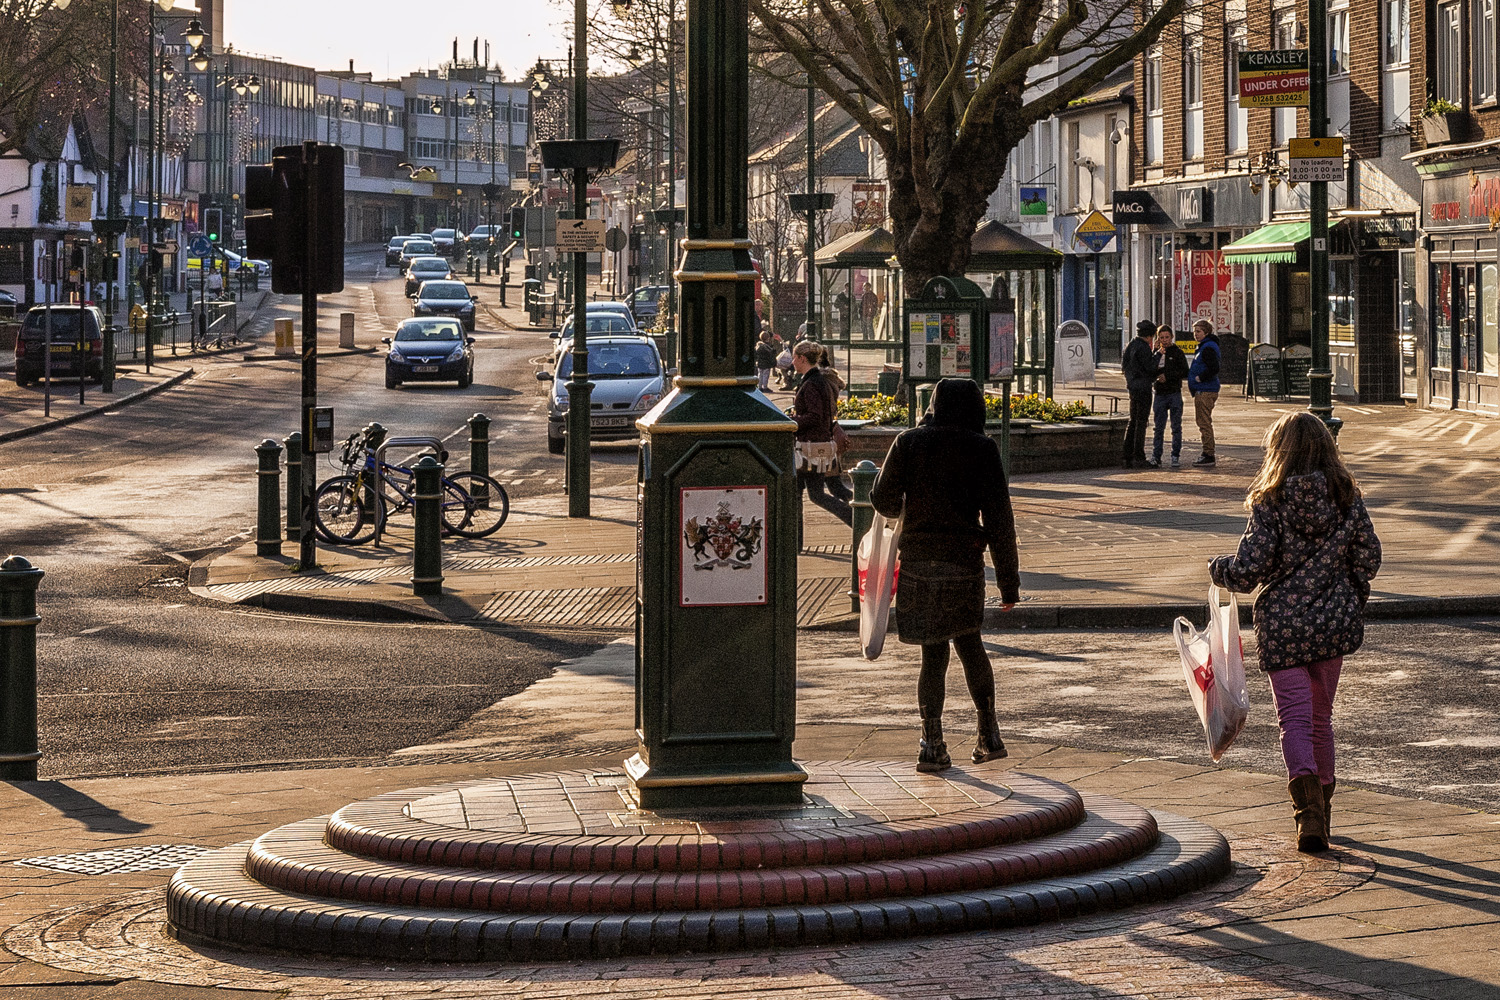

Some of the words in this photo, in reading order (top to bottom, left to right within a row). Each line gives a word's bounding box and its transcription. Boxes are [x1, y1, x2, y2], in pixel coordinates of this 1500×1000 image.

[1248, 52, 1304, 65] KEMSLEY
[1244, 80, 1278, 92] UNDER
[1280, 76, 1310, 88] OFFER
[1317, 240, 1323, 249] 1
[1193, 267, 1232, 276] CLEARANC
[1199, 309, 1212, 317] £15
[1067, 344, 1084, 360] 50
